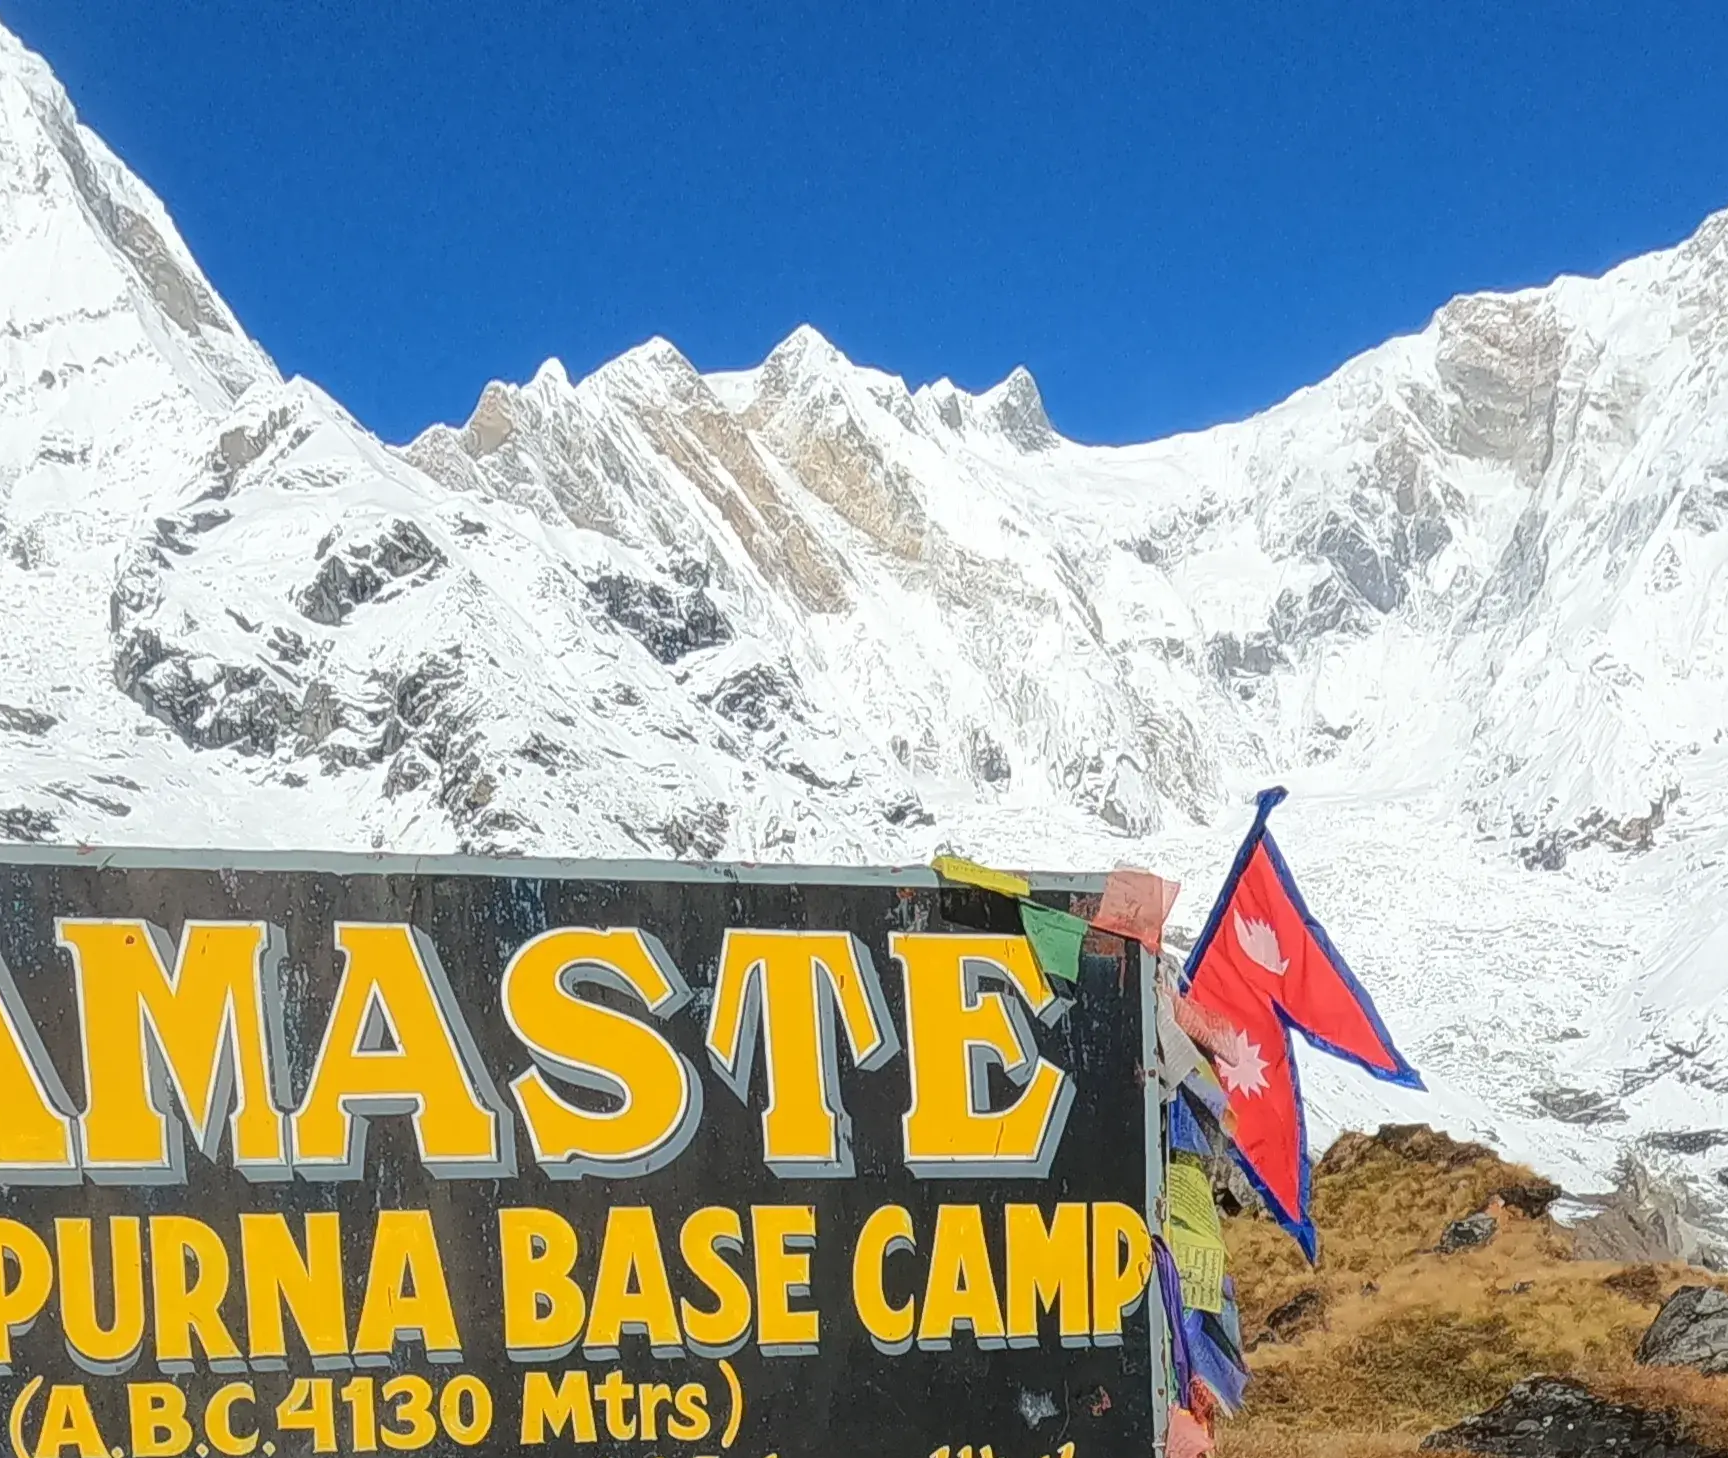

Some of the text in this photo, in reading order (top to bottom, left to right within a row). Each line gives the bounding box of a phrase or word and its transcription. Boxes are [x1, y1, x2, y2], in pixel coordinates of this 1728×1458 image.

[499, 1204, 820, 1362] BASE
[852, 1201, 1153, 1356] CAMP
[519, 1359, 742, 1449] Mtrs)
